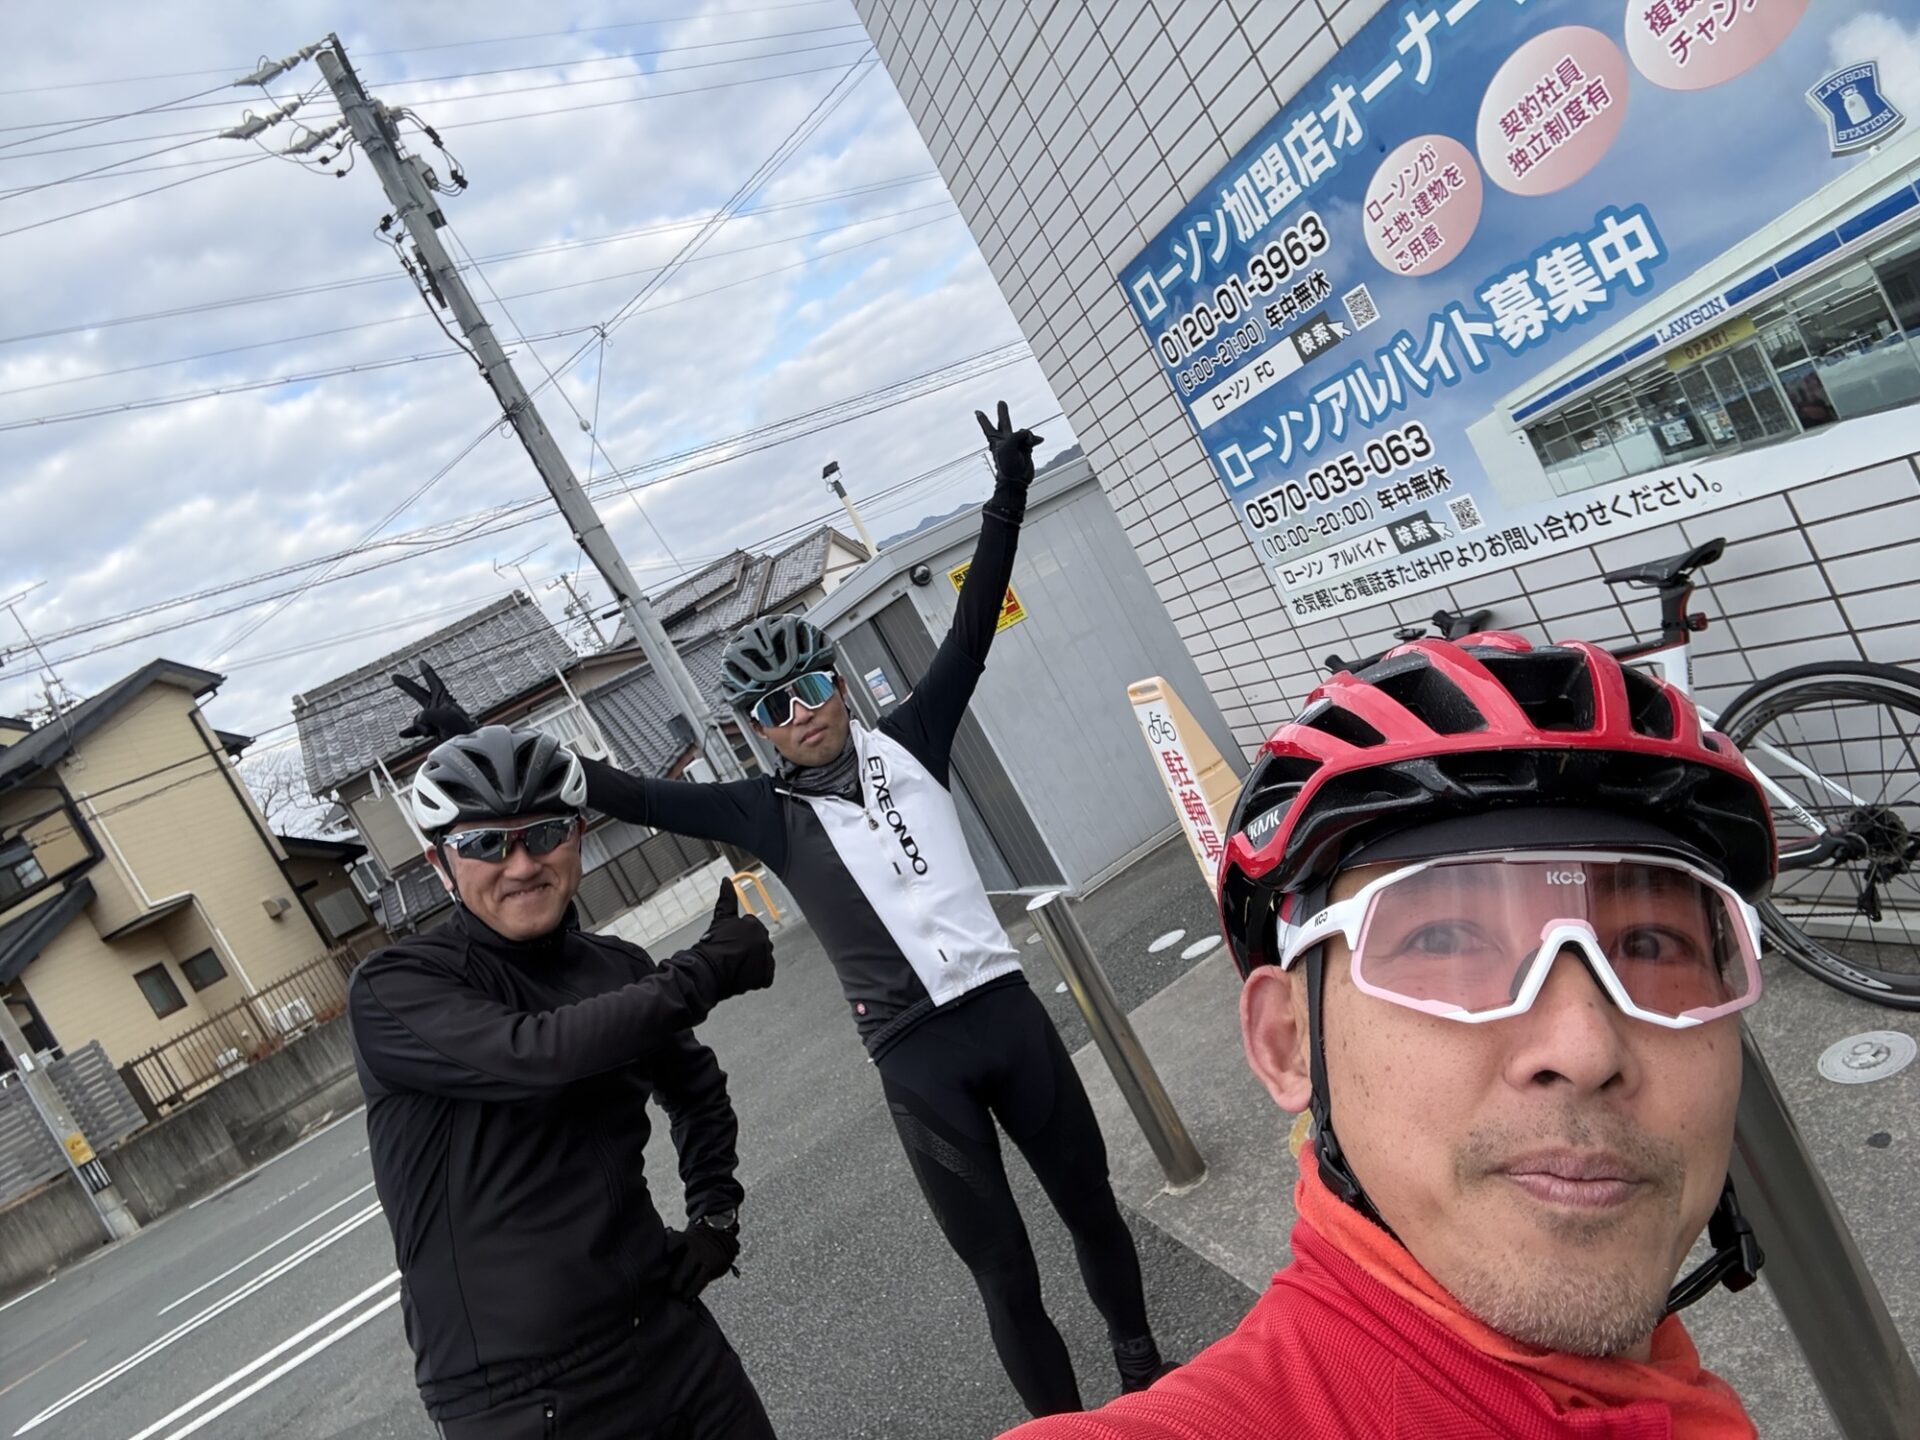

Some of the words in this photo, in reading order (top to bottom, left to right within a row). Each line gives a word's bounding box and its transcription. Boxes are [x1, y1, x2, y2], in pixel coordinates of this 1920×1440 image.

[1669, 0, 1755, 64] チャン
[1500, 57, 1584, 142] 契約社員
[1817, 66, 1873, 100] LAWSON
[1838, 108, 1894, 140] STATION
[1132, 0, 1526, 321] ローソン加盟店オーナー
[1507, 78, 1612, 177] 独立制度有
[1366, 144, 1437, 223] ローソンが
[1382, 165, 1465, 249] 土地・建物を
[1161, 215, 1327, 364] 0120-01-3963
[1395, 226, 1443, 272] ご用意
[1266, 270, 1331, 329] 年中無休
[1658, 296, 1726, 343] LAWSON
[1212, 376, 1250, 411] ローソン
[1254, 360, 1275, 383] FC
[1297, 321, 1333, 355] 検索
[1218, 212, 1660, 487] ローソンアルバイト募集中
[1245, 424, 1431, 529] 0570-035-063
[1377, 466, 1451, 512] 年中無休
[1283, 560, 1324, 585] ローソン
[1329, 537, 1387, 569] アルバイト
[1395, 518, 1432, 547] 検索
[1291, 472, 1724, 616] お気軽にお電話またはHPよりお問い合わせください。
[867, 756, 928, 876] ETXEONDO
[1161, 750, 1225, 862] 駐輪場
